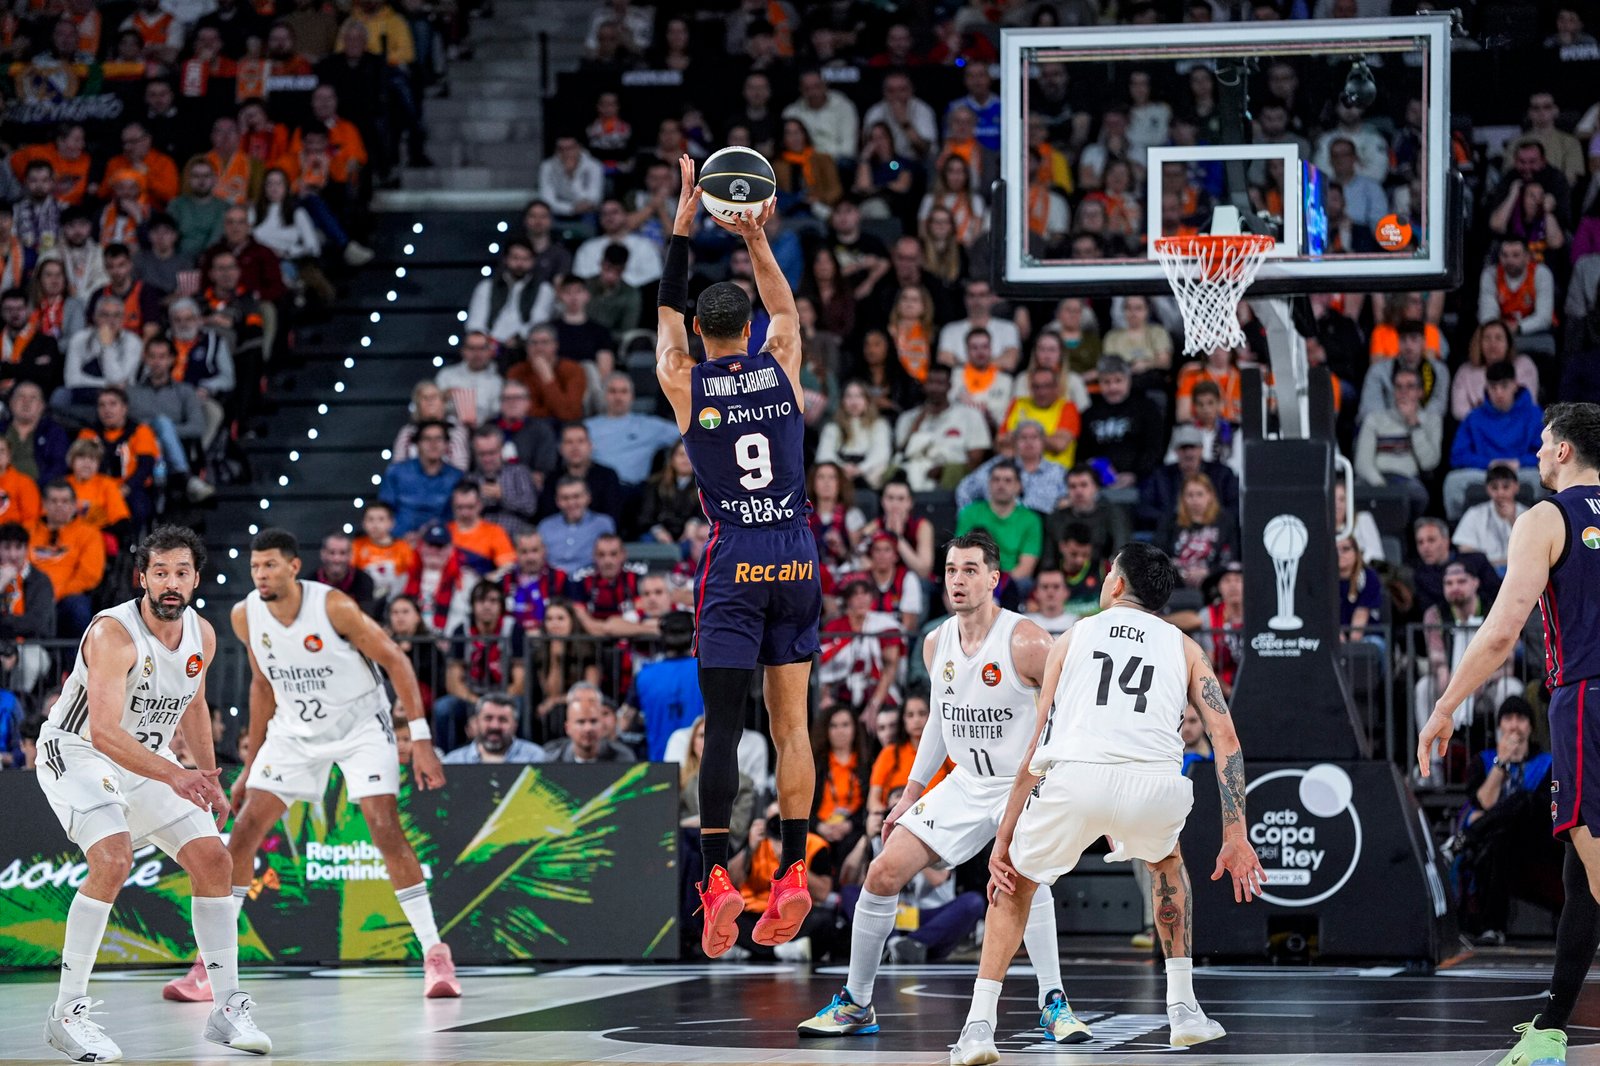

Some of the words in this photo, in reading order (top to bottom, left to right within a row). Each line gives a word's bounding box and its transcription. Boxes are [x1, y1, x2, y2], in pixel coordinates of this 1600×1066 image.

[702, 367, 780, 396] LUWAWU-CABARROT
[727, 402, 791, 424] AMUTIO
[735, 432, 774, 490] 9
[721, 496, 774, 513] araba
[1109, 625, 1146, 643] DECK
[1251, 637, 1284, 650] Copa
[1298, 637, 1320, 651] Rey
[267, 665, 334, 681] Emirates
[1092, 651, 1155, 713] 14
[294, 699, 327, 722] 22
[942, 702, 1013, 722] Emirates
[952, 724, 966, 738] FLY
[969, 725, 1003, 739] BETTER
[969, 747, 996, 776] 11
[1263, 809, 1298, 825] acb
[1250, 823, 1315, 847] Copa
[1281, 846, 1325, 870] Rey
